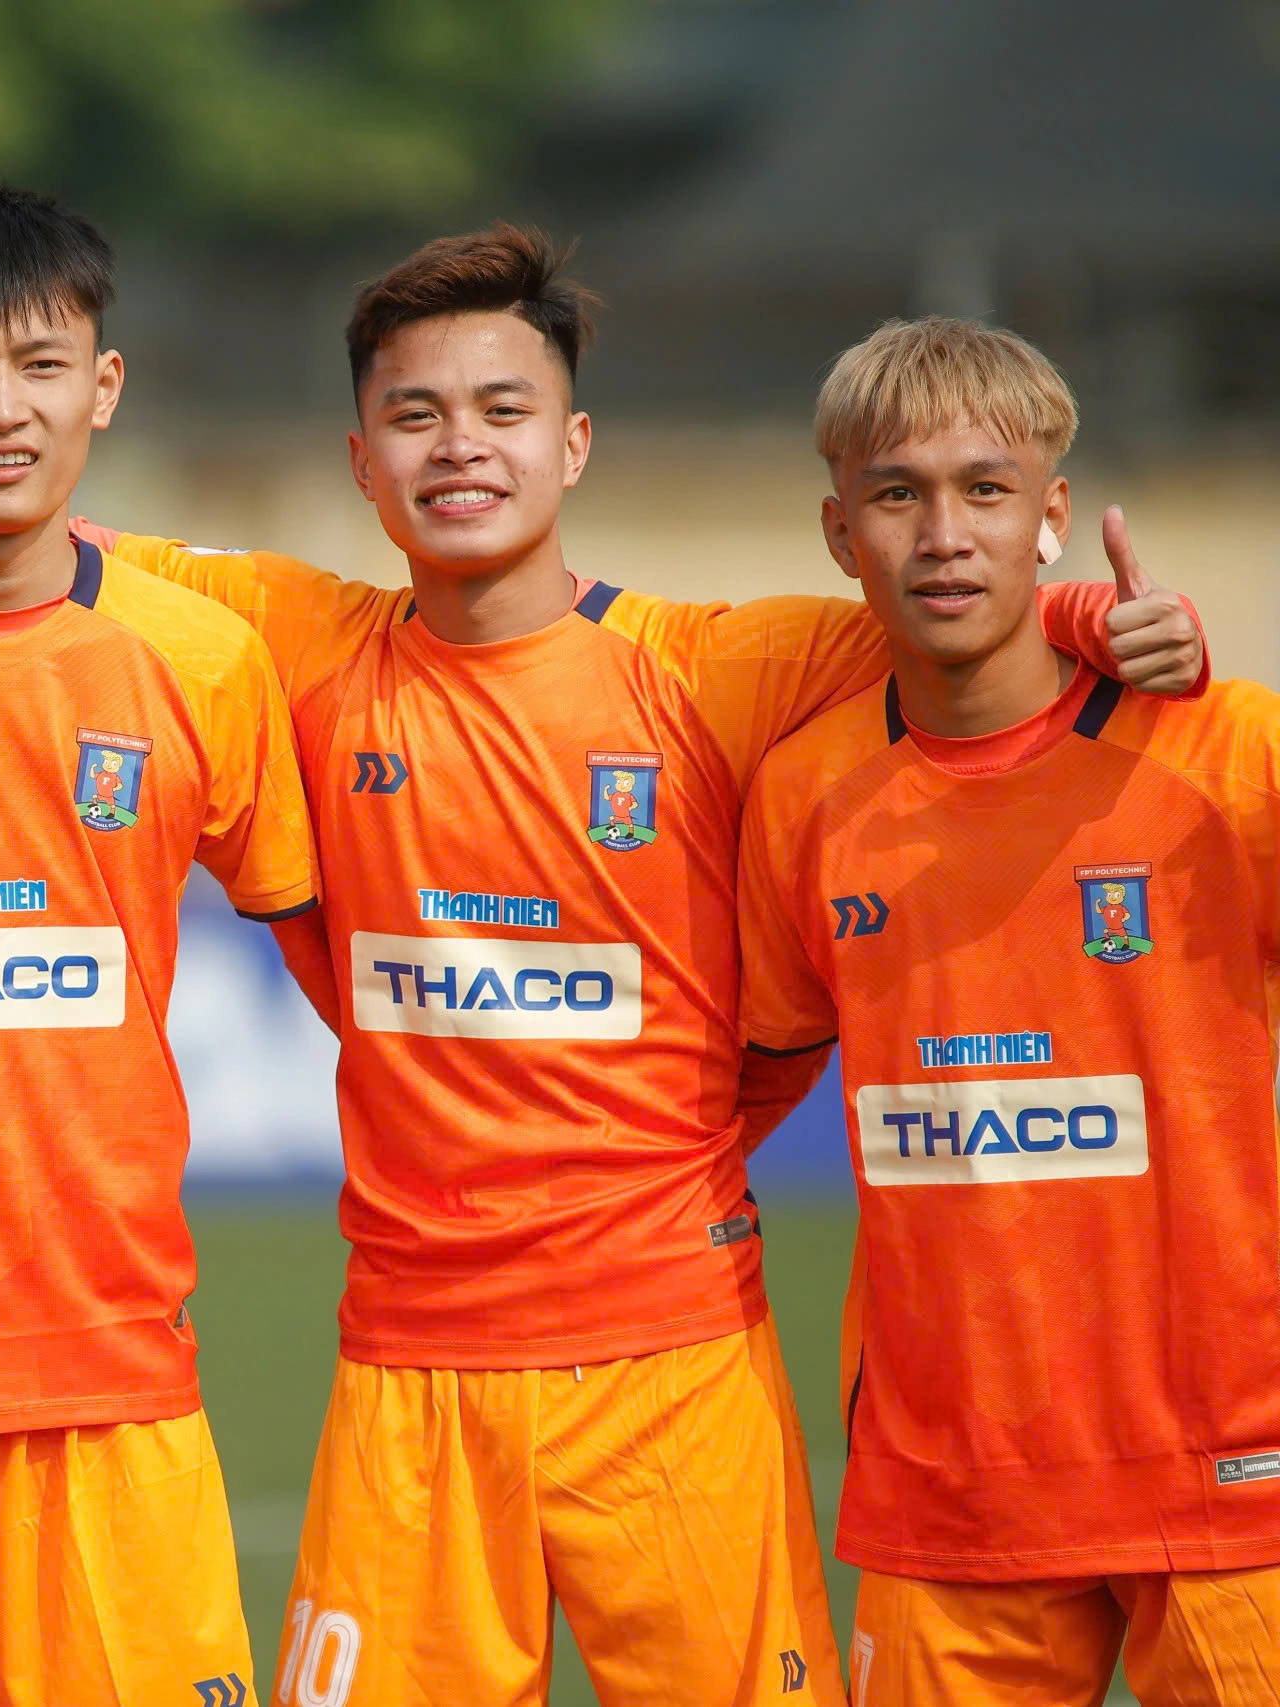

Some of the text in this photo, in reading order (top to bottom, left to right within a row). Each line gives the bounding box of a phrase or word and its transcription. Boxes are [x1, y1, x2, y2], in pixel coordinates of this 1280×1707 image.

[82, 732, 148, 749] FPT POLYTECHNIC
[591, 755, 659, 764] FPT POLYTECHNIC
[102, 777, 111, 785] F
[617, 797, 625, 806] F
[86, 817, 109, 828] FOOTBALL
[605, 840, 629, 848] FOOTBALL
[1080, 866, 1147, 876] FPT POLYTECHNIC
[418, 889, 559, 928] THANH NIÊN
[1110, 909, 1117, 918] F
[1102, 952, 1126, 961] FOOTBALL
[373, 960, 614, 1012] THACO
[917, 1029, 1053, 1068] THANH NIÊN
[883, 1105, 1119, 1158] THACO
[1244, 1460, 1280, 1473] AUTHENTIC
[279, 1599, 362, 1707] 10
